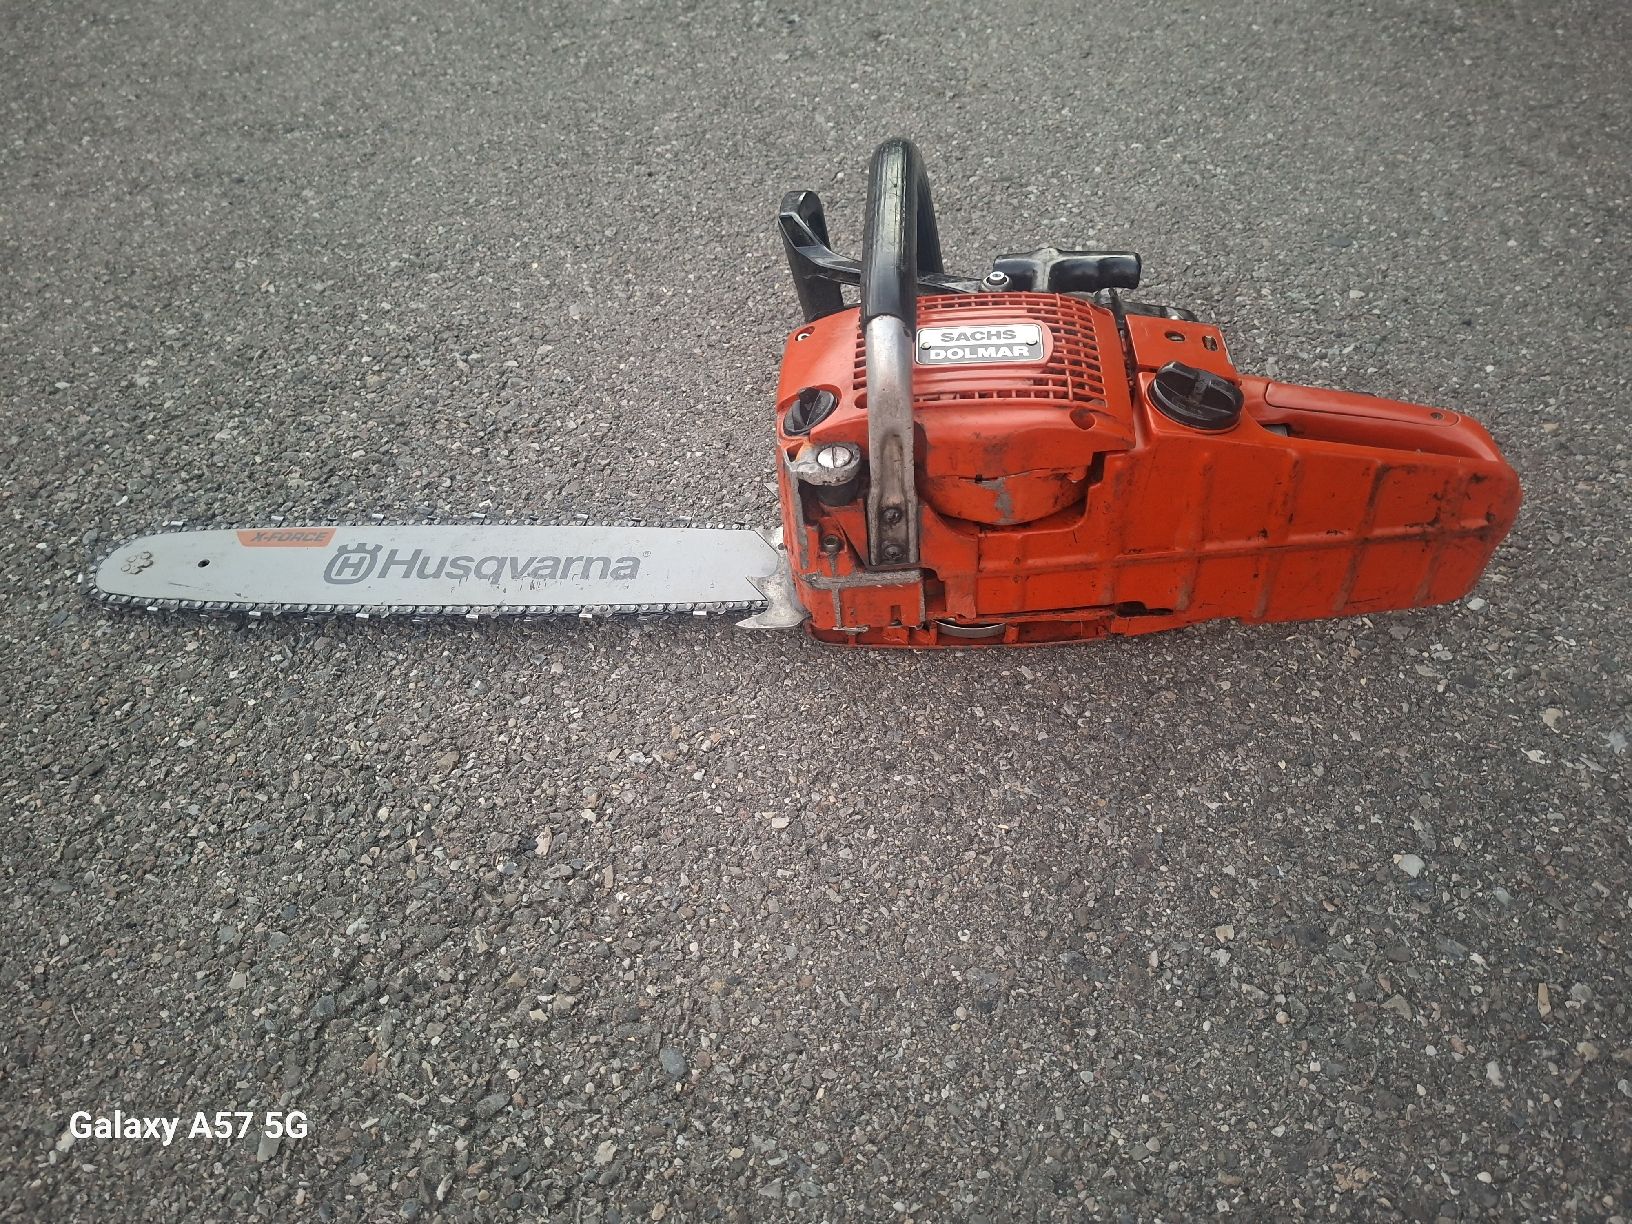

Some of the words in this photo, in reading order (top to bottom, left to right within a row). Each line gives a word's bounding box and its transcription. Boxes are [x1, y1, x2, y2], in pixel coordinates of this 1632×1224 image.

[940, 329, 1017, 343] SACHS
[929, 345, 1030, 360] DOLMAR
[250, 531, 329, 542] X-FORCE
[377, 549, 641, 585] Husqvarna
